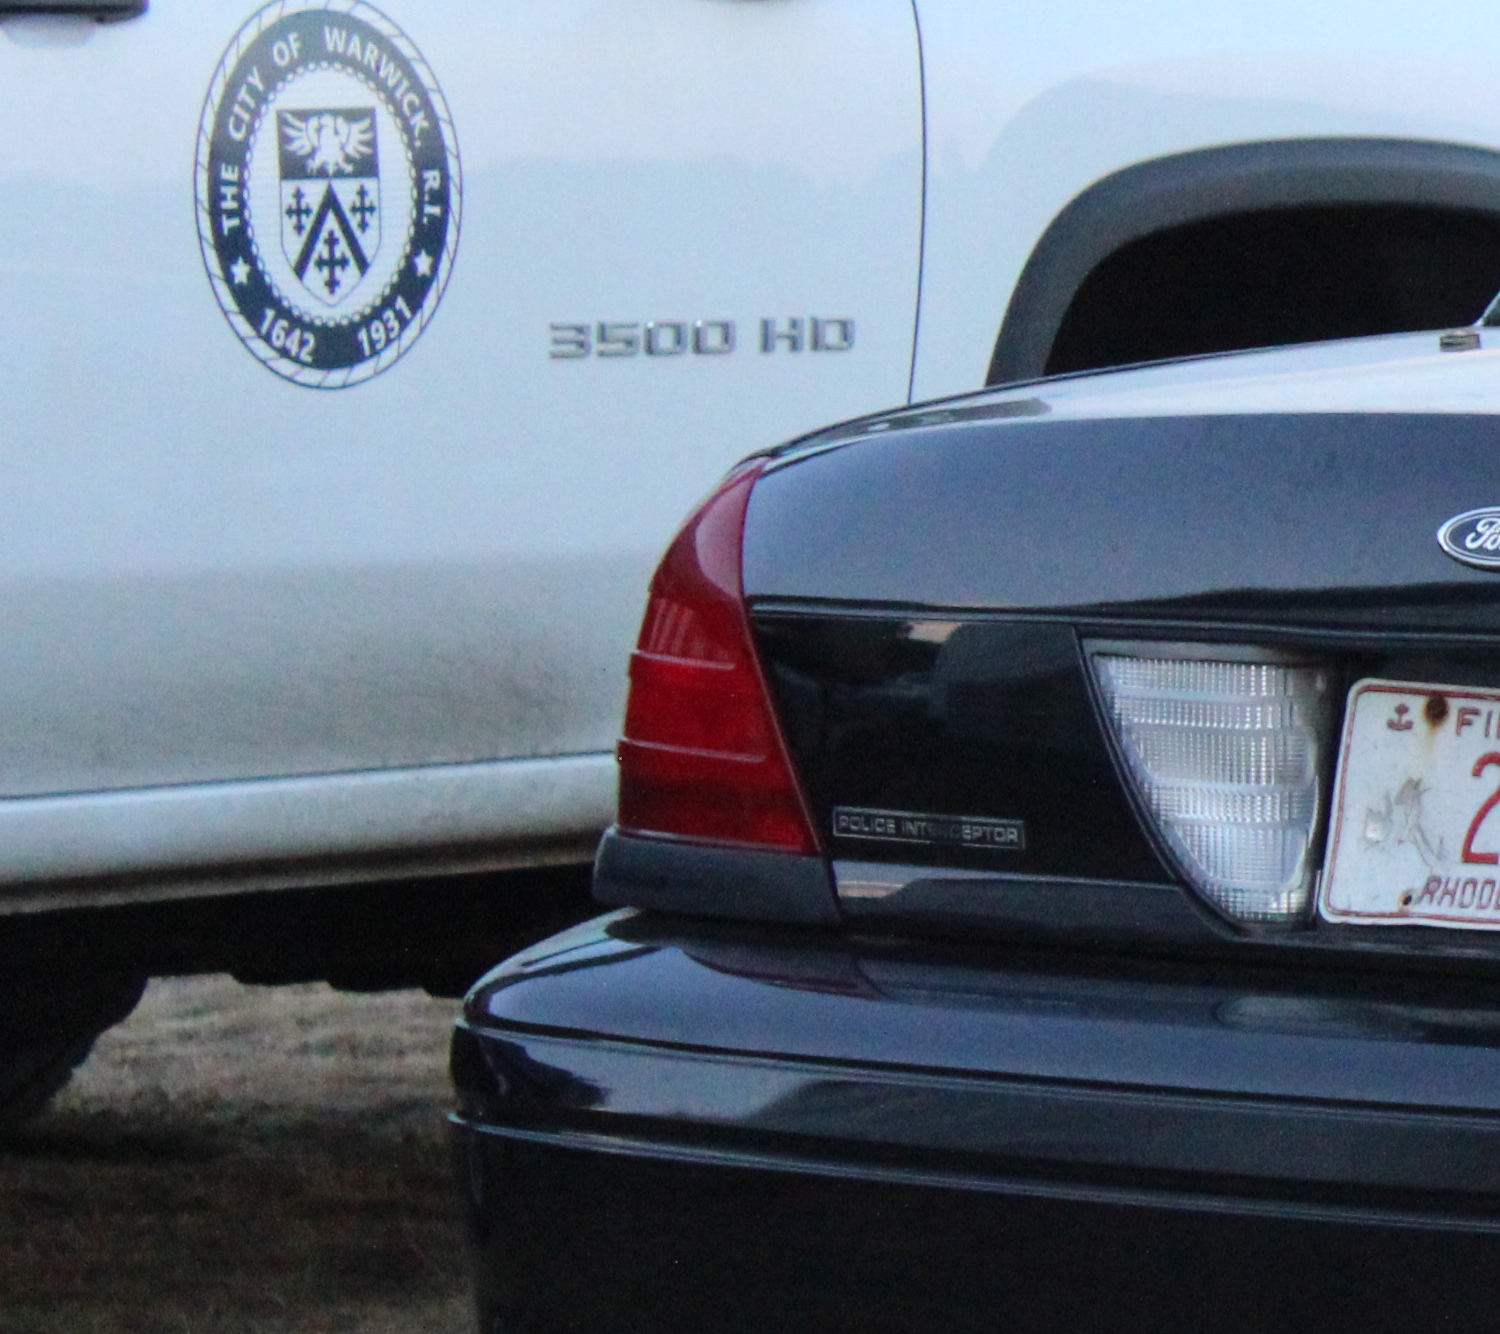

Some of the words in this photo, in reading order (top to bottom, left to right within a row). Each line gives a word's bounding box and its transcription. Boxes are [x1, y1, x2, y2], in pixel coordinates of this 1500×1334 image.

[272, 31, 301, 68] OF
[228, 66, 265, 142] CITY
[219, 163, 241, 236] THE
[421, 169, 442, 225] R.I.
[260, 308, 316, 364] 1642
[357, 295, 413, 356] 1931
[548, 320, 738, 359] 3500
[759, 317, 856, 355] HD
[837, 814, 897, 835] POLICE
